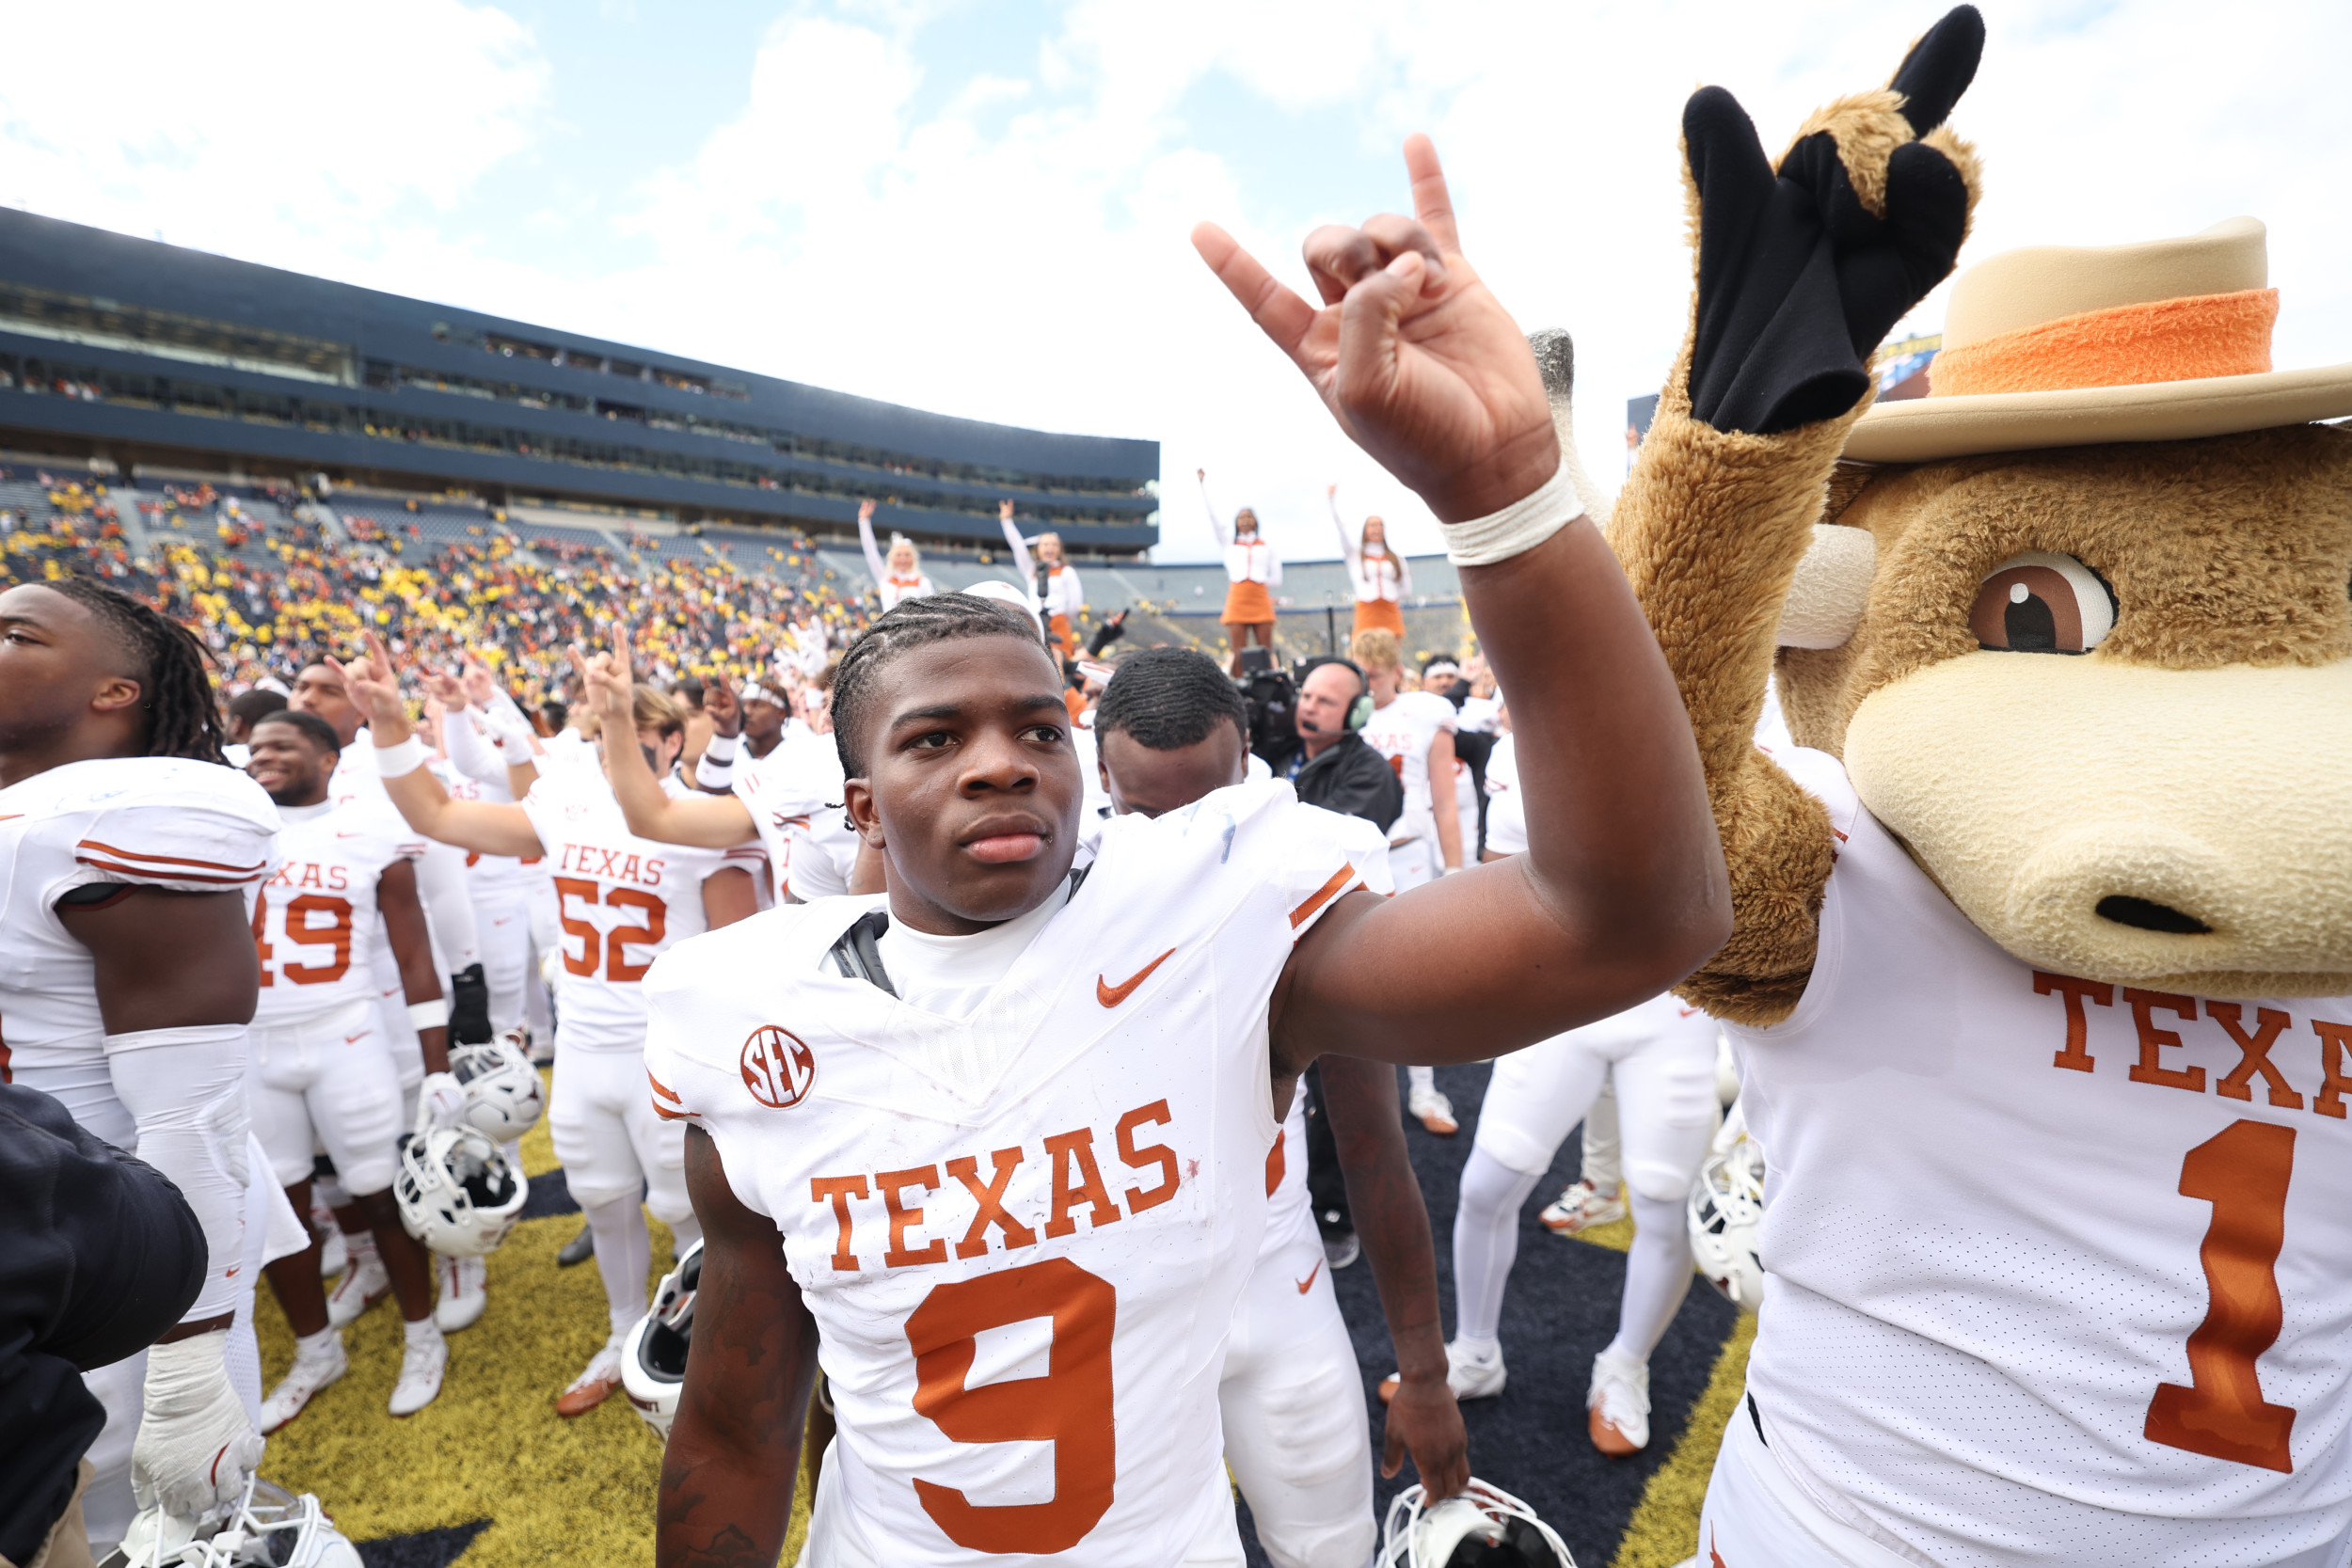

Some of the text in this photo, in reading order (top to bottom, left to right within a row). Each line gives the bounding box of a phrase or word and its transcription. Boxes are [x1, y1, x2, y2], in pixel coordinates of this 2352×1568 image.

[267, 862, 348, 890] XAS
[562, 844, 664, 886] TEXAS
[552, 877, 666, 981] 52
[743, 1029, 810, 1103] SEC
[811, 1099, 1181, 1271] TEXAS
[2144, 1119, 2296, 1474] 1
[905, 1258, 1116, 1554] 9
